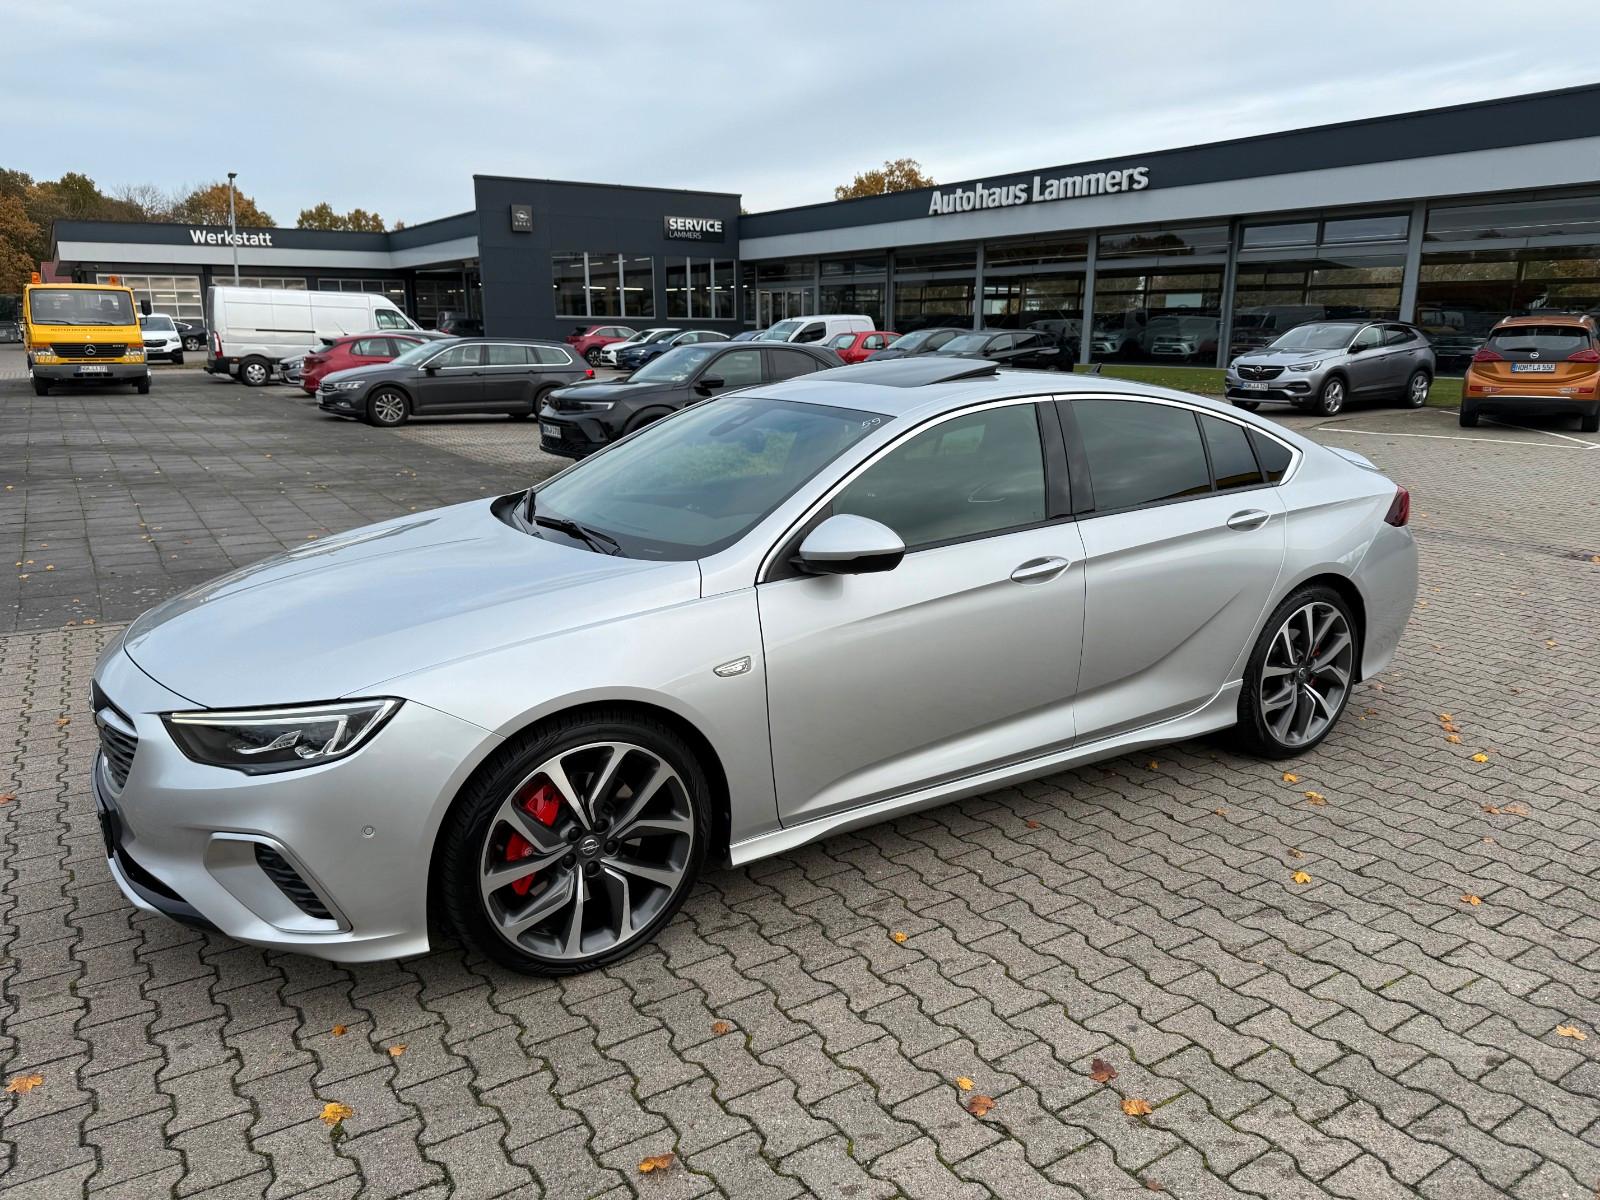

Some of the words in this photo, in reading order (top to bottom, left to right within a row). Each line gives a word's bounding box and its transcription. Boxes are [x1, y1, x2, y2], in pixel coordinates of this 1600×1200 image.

[928, 182, 1029, 216] Autohaus
[1032, 166, 1150, 202] Lammers
[669, 218, 723, 233] SERVICE
[189, 229, 273, 246] Werkstatt
[669, 230, 702, 240] LAMMERS
